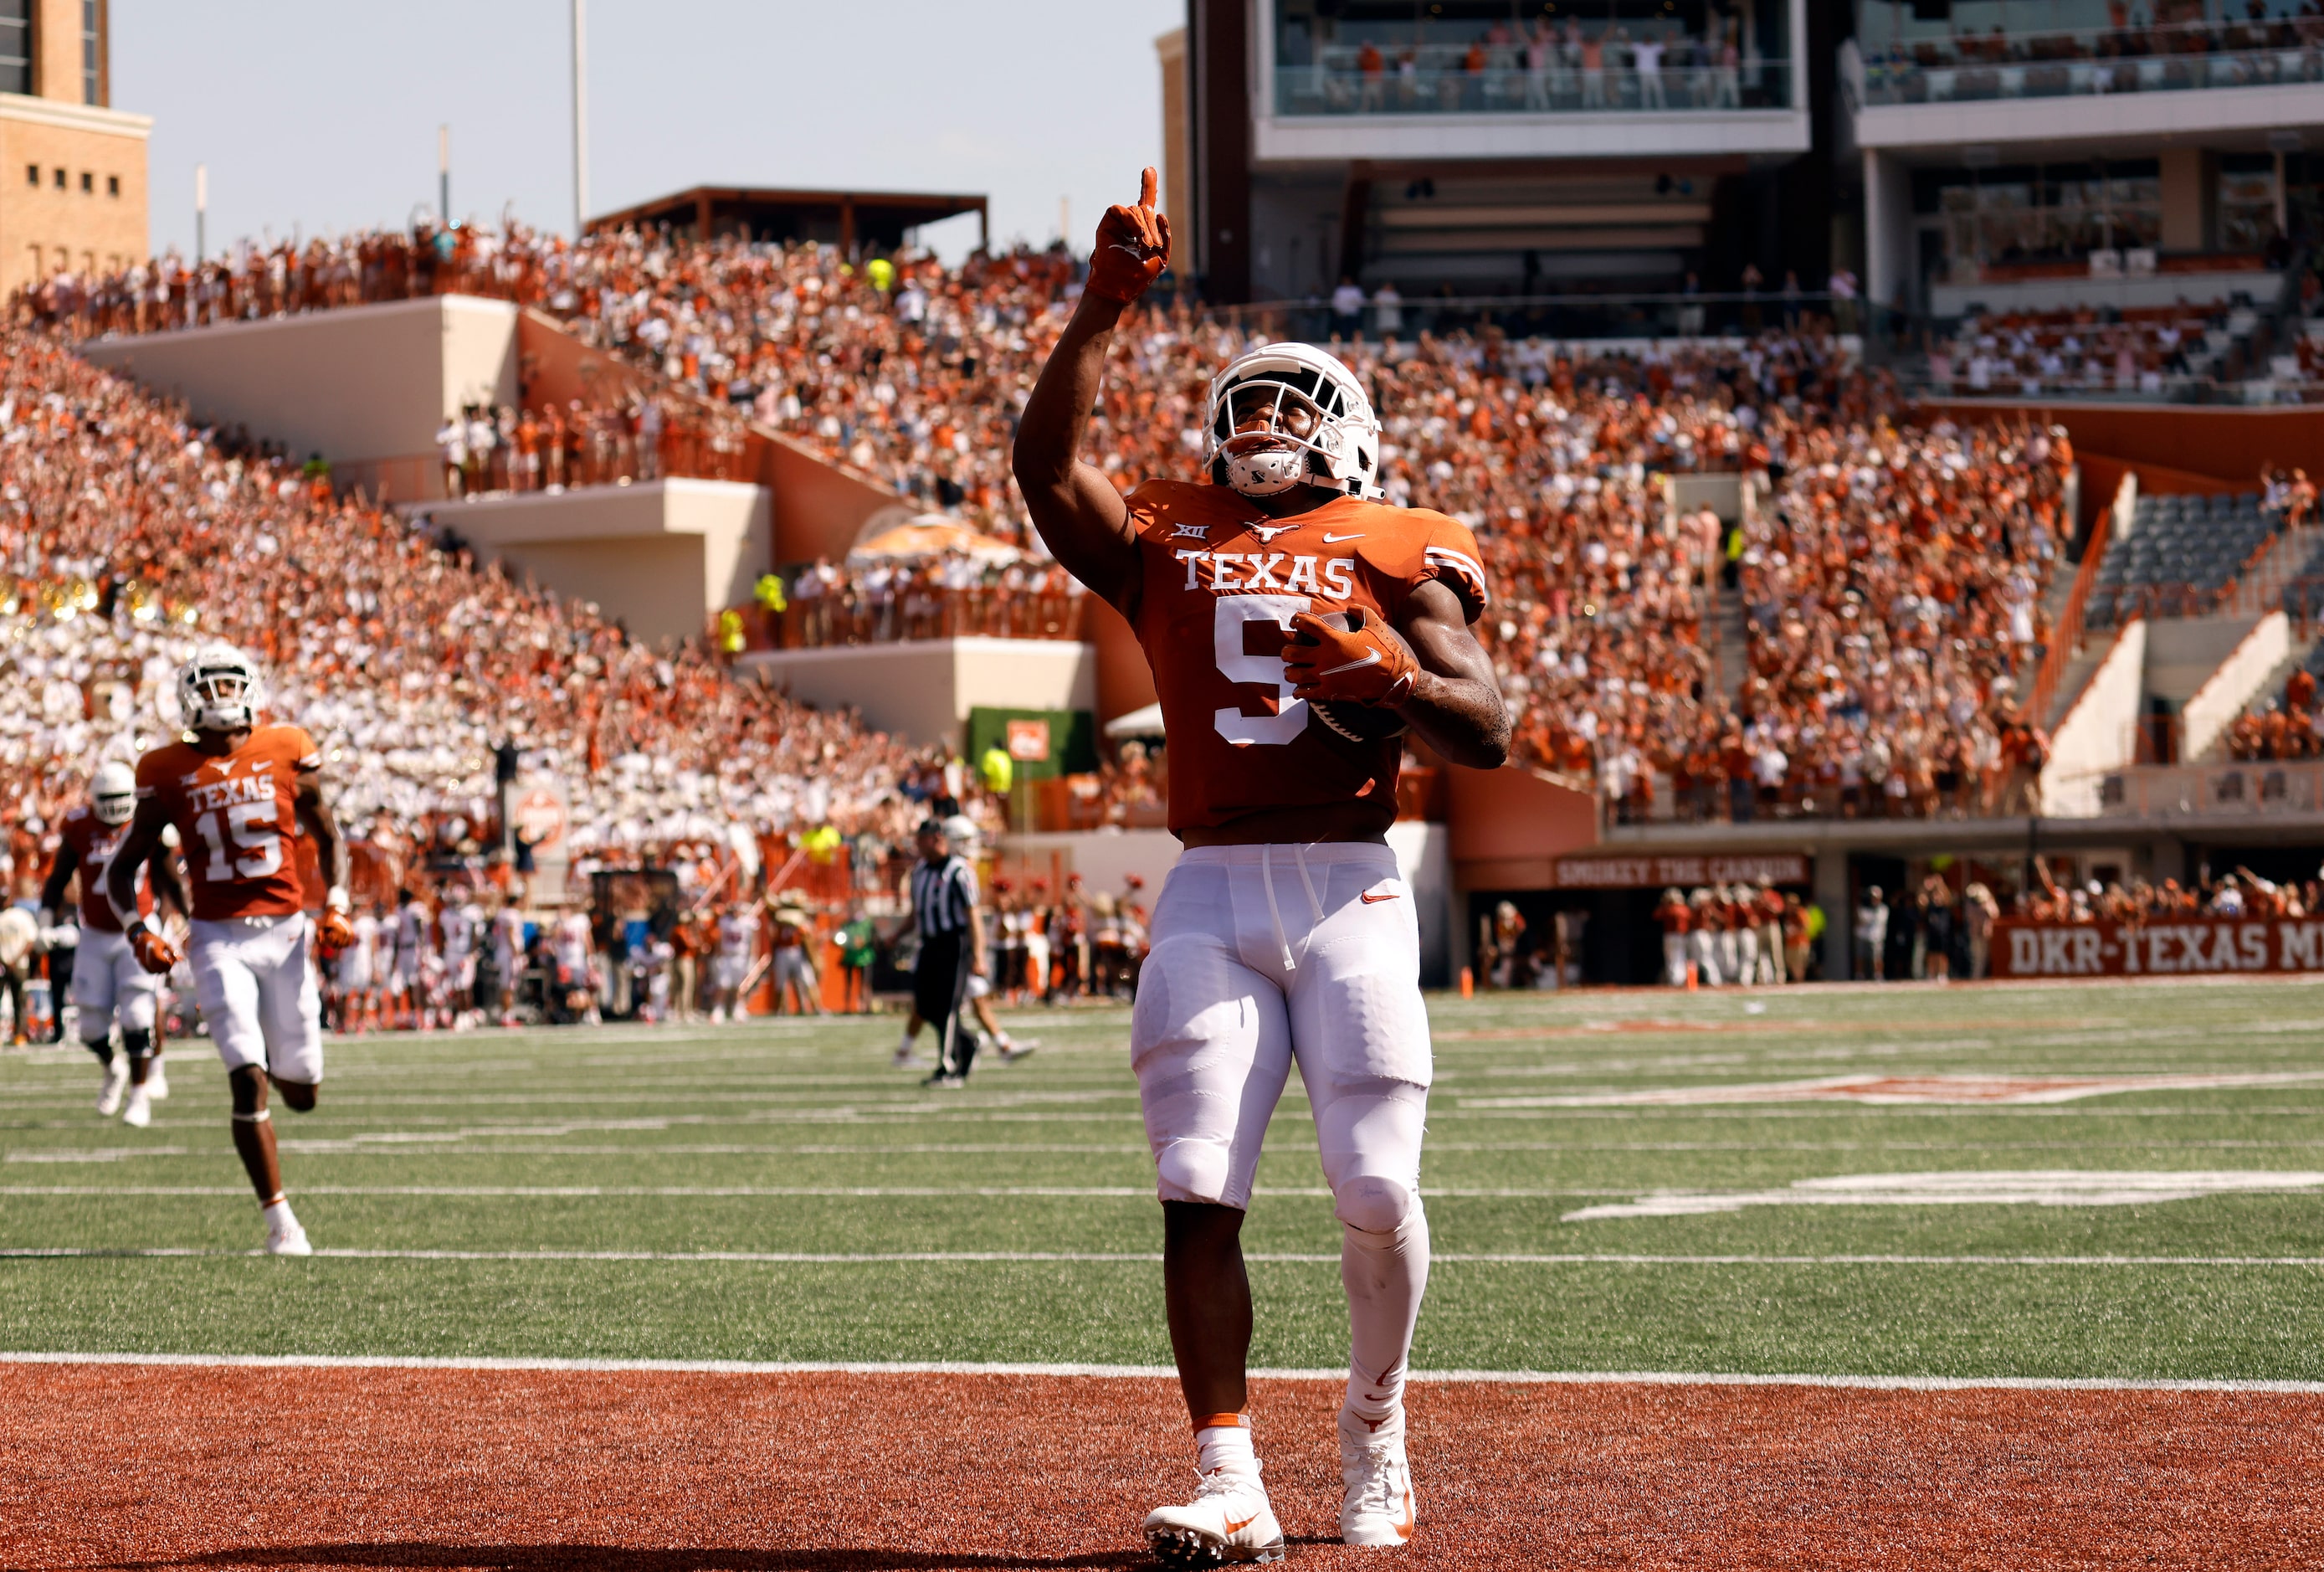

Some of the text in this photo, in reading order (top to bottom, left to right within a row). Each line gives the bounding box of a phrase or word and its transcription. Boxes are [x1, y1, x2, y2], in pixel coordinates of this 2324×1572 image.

[1171, 522, 1210, 540] XII
[1174, 548, 1355, 601] TEXAS
[1214, 593, 1311, 746] 5
[186, 773, 277, 814] TEXAS
[194, 799, 284, 882] 15
[2009, 923, 2269, 974] DKR-TEXAS
